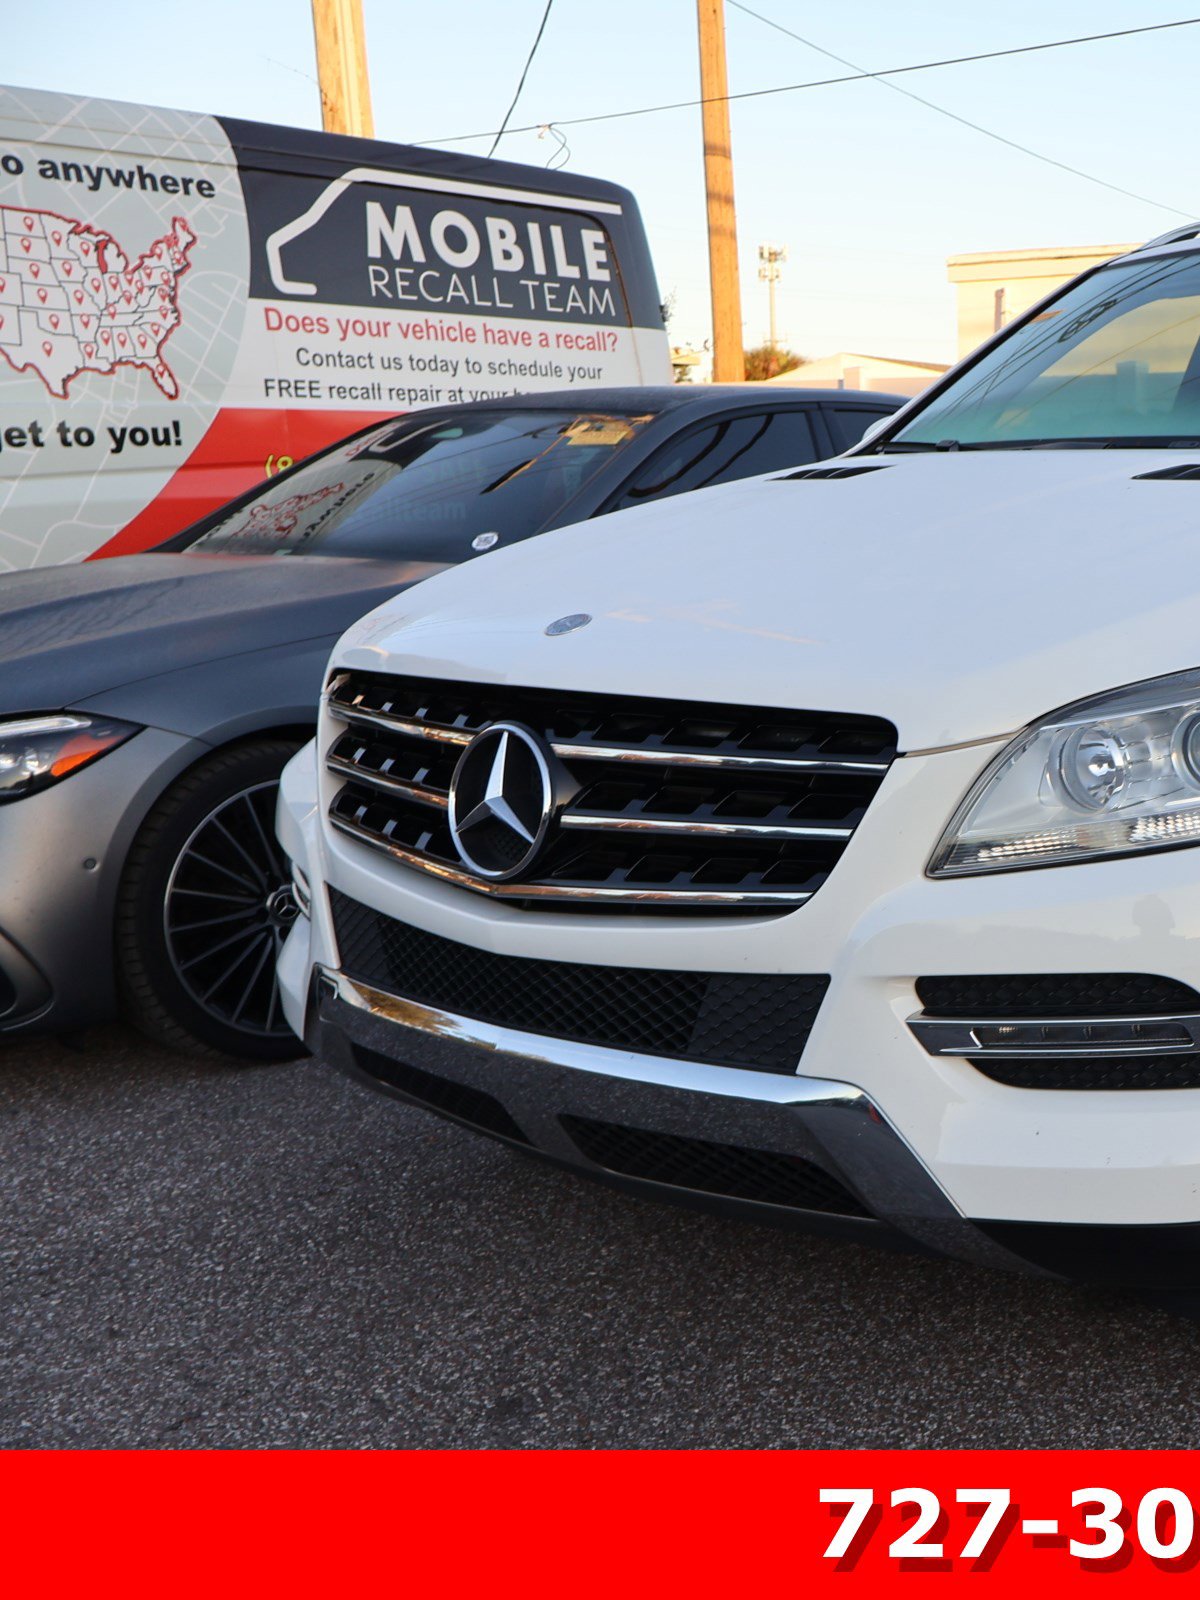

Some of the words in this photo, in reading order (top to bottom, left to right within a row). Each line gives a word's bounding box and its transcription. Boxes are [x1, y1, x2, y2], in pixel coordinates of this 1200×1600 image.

[0, 154, 25, 176] o
[36, 157, 217, 199] anywhere
[364, 200, 612, 283] MOBILE
[367, 264, 514, 309] RECALL
[518, 278, 616, 318] TEAM
[263, 306, 330, 335] Does
[336, 317, 392, 342] your
[397, 317, 477, 344] vehicle
[482, 322, 533, 347] have
[538, 331, 550, 349] a
[555, 331, 619, 353] recall?
[295, 346, 376, 370] Contact
[379, 357, 404, 371] us
[408, 353, 460, 377] today
[464, 356, 483, 375] to
[487, 358, 564, 379] schedule
[567, 364, 604, 383] your
[263, 377, 322, 400] FREE
[328, 381, 382, 401] recall
[388, 383, 443, 406] repair
[447, 385, 466, 404] at
[0, 419, 45, 454] et
[56, 419, 96, 448] to
[106, 419, 184, 454] you!
